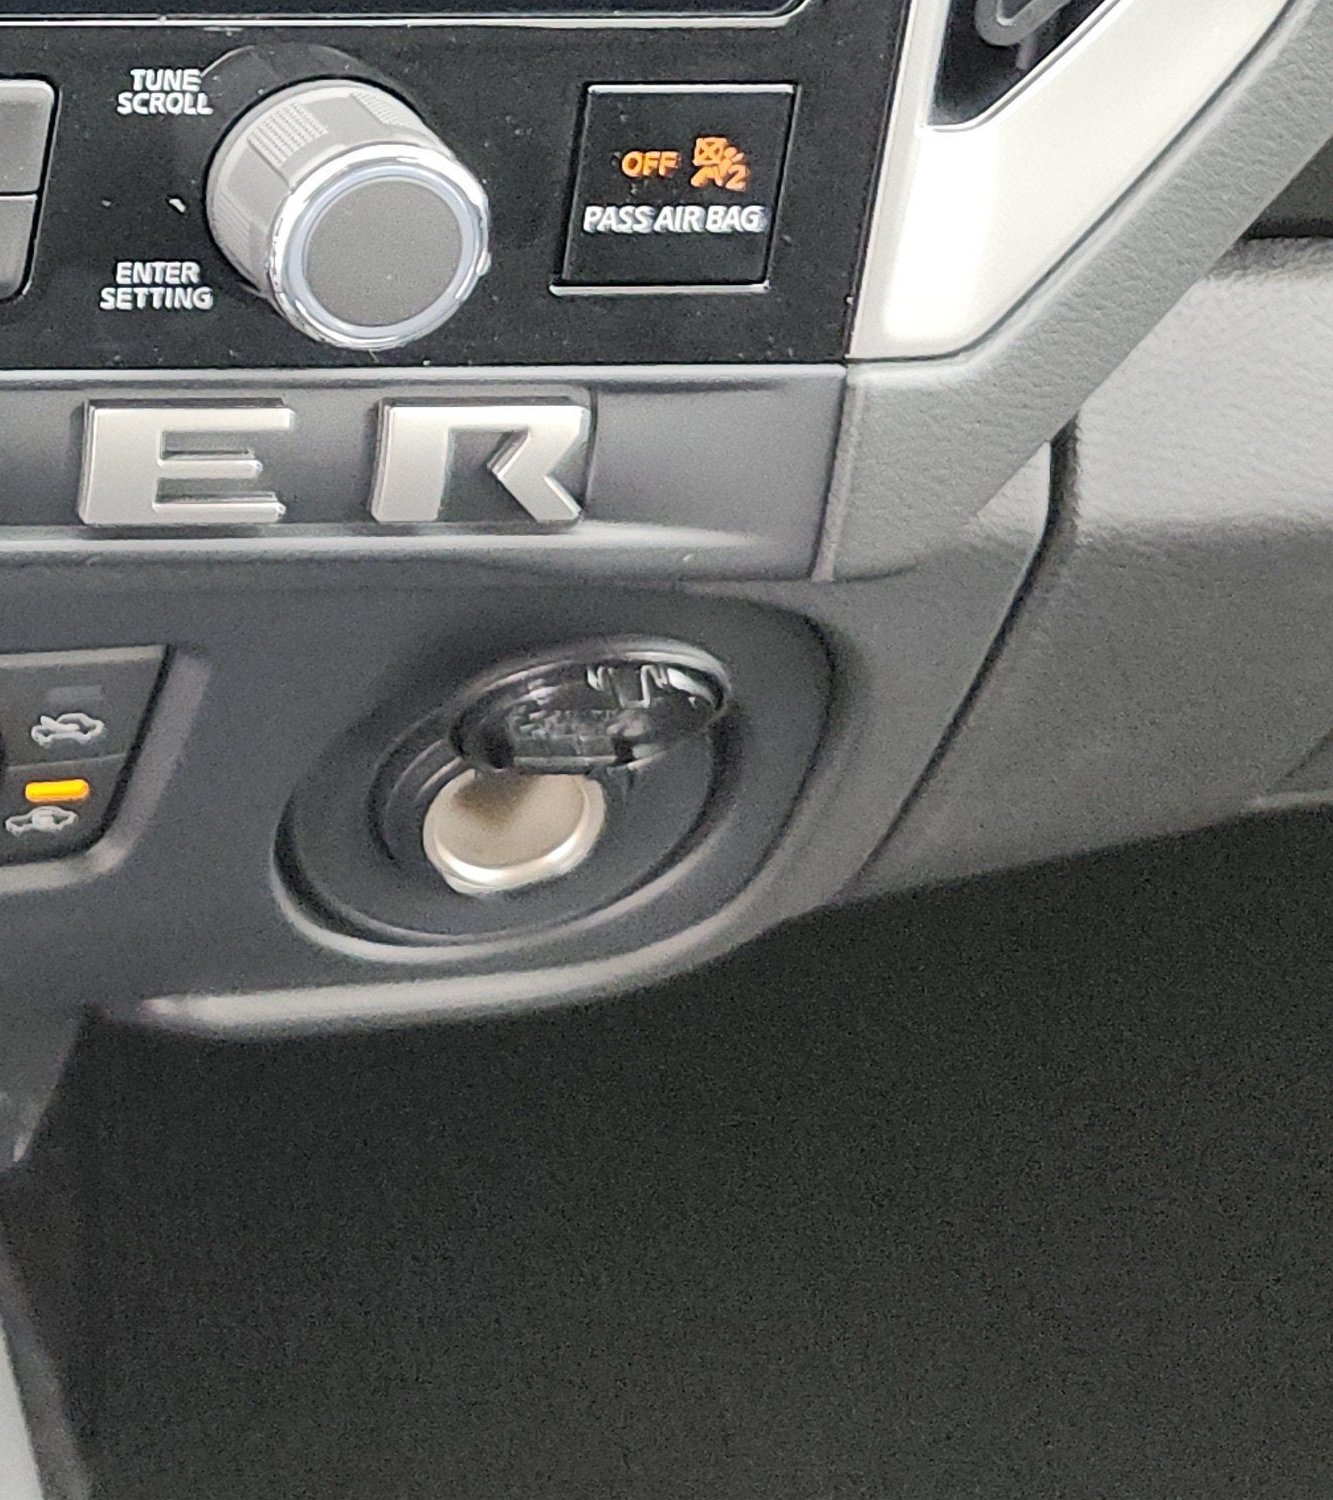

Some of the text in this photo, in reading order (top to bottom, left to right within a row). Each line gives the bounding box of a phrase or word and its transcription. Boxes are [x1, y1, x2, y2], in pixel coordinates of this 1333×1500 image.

[130, 68, 202, 92] TUNE
[116, 92, 213, 116] SCROLL
[620, 150, 683, 179] OFF
[583, 204, 768, 234] PASS AIR BAG
[115, 260, 201, 285] ENTER
[99, 285, 214, 311] SETTING
